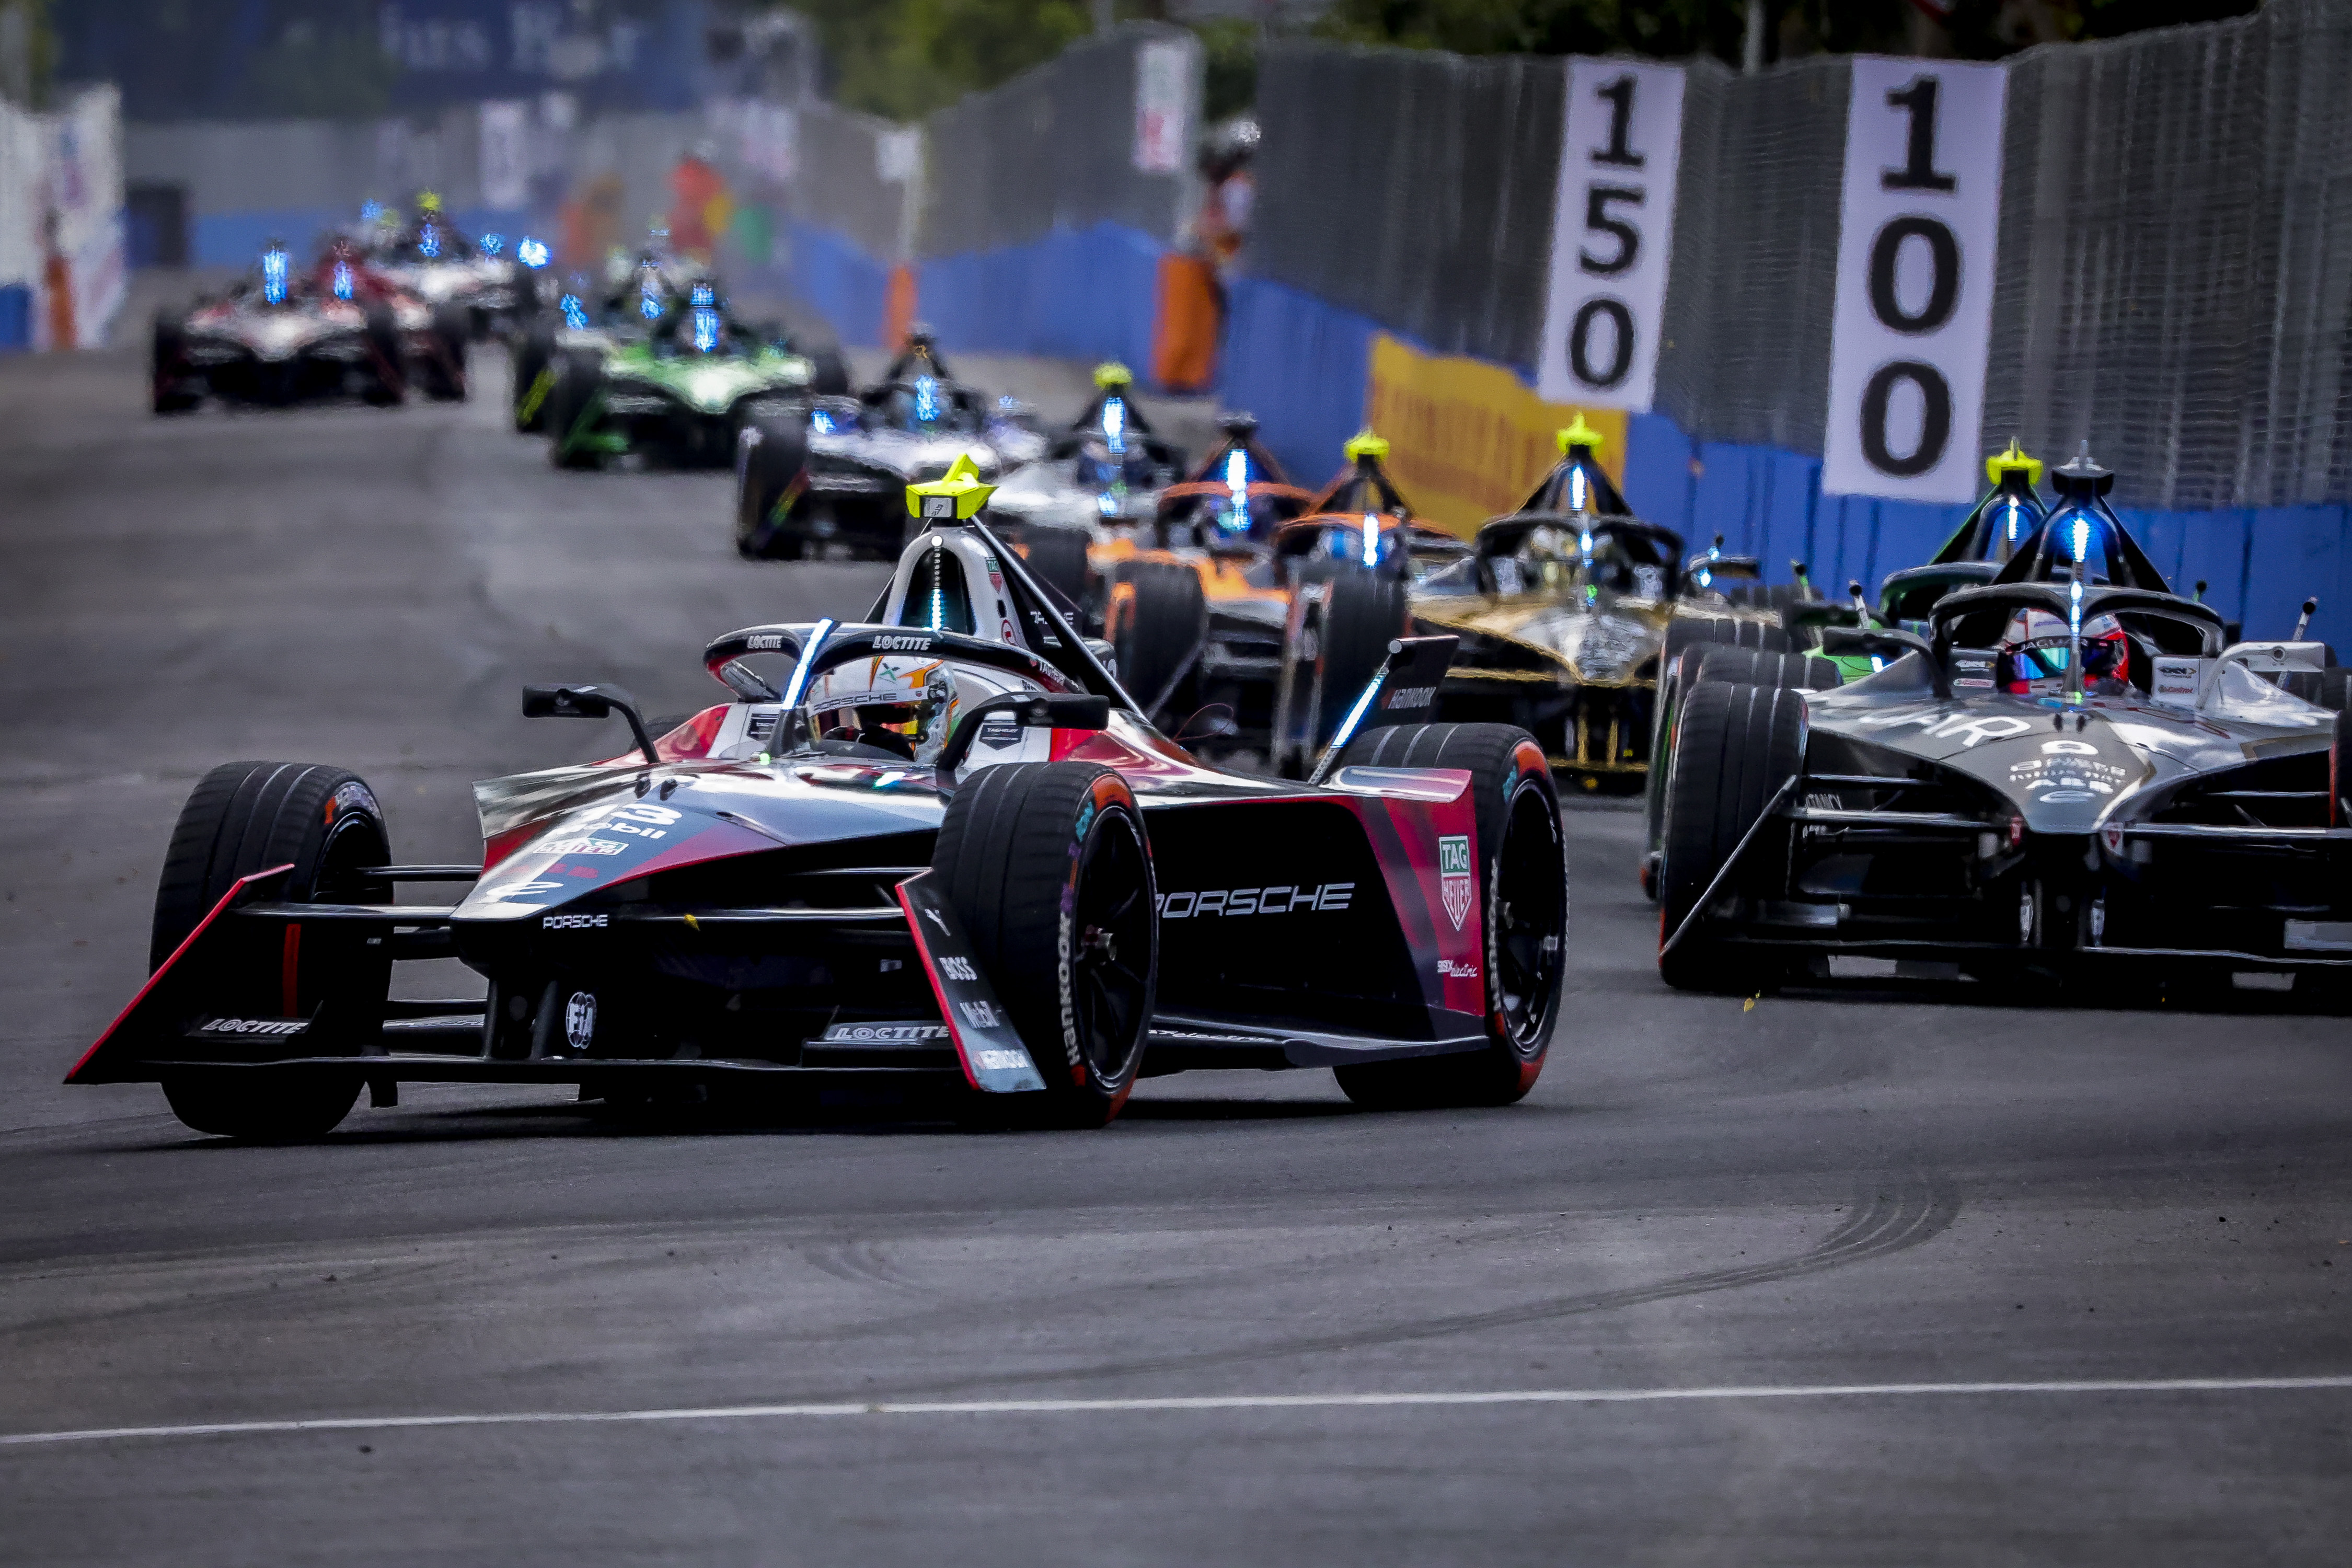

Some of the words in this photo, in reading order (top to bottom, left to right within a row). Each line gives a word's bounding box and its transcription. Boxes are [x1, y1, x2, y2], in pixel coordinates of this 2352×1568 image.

[1567, 74, 1646, 388] 150
[1859, 75, 1961, 477] 100
[747, 635, 783, 649] LOCTITE
[872, 636, 932, 650] LOCTITE
[1443, 843, 1468, 870] TAG
[543, 914, 608, 929] PORSCHE
[939, 956, 977, 981] BOSS
[201, 1019, 308, 1034] LOCTITE
[834, 1026, 950, 1040] LOCTITE
